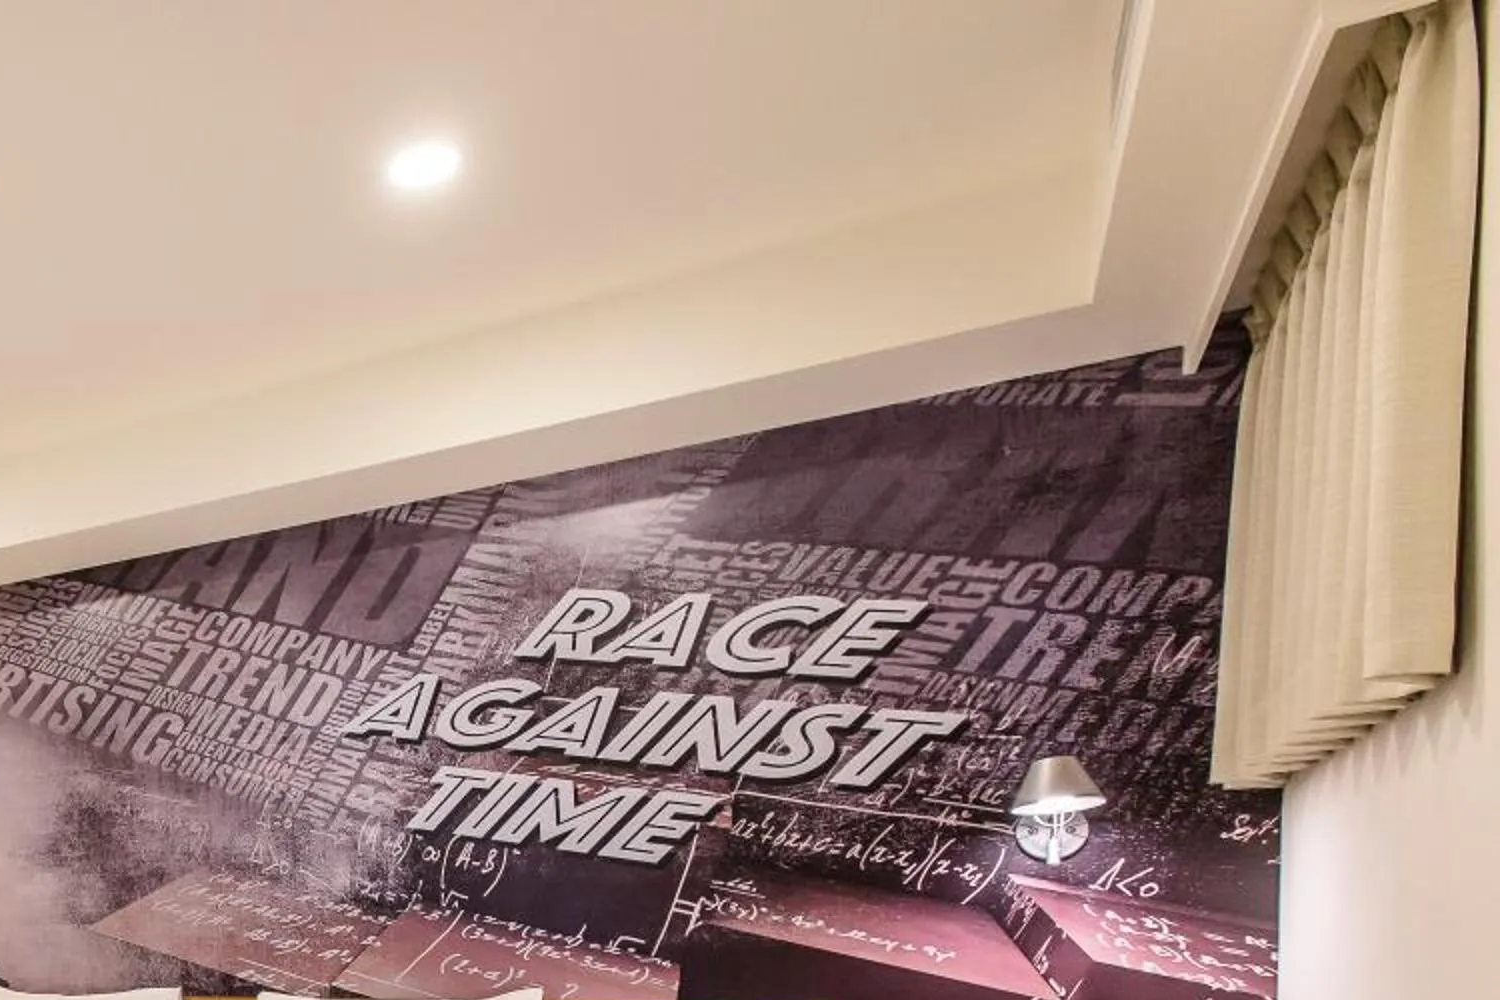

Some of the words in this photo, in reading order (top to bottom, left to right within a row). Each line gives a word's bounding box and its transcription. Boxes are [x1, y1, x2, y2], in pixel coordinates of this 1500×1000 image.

[777, 543, 956, 598] VALUE
[49, 636, 109, 671] LOCAL
[87, 625, 150, 690] FOCUS
[110, 603, 203, 703] IMAGE
[195, 611, 390, 681] COMPANY
[409, 601, 455, 657] LABEL
[512, 588, 934, 678] RACE
[149, 684, 200, 718] DESIGN
[167, 640, 344, 727] TREND
[176, 731, 296, 784] ORIENTATION
[186, 698, 313, 766] MEDIA
[342, 672, 968, 788] AGAINST
[405, 765, 720, 865] TIME
